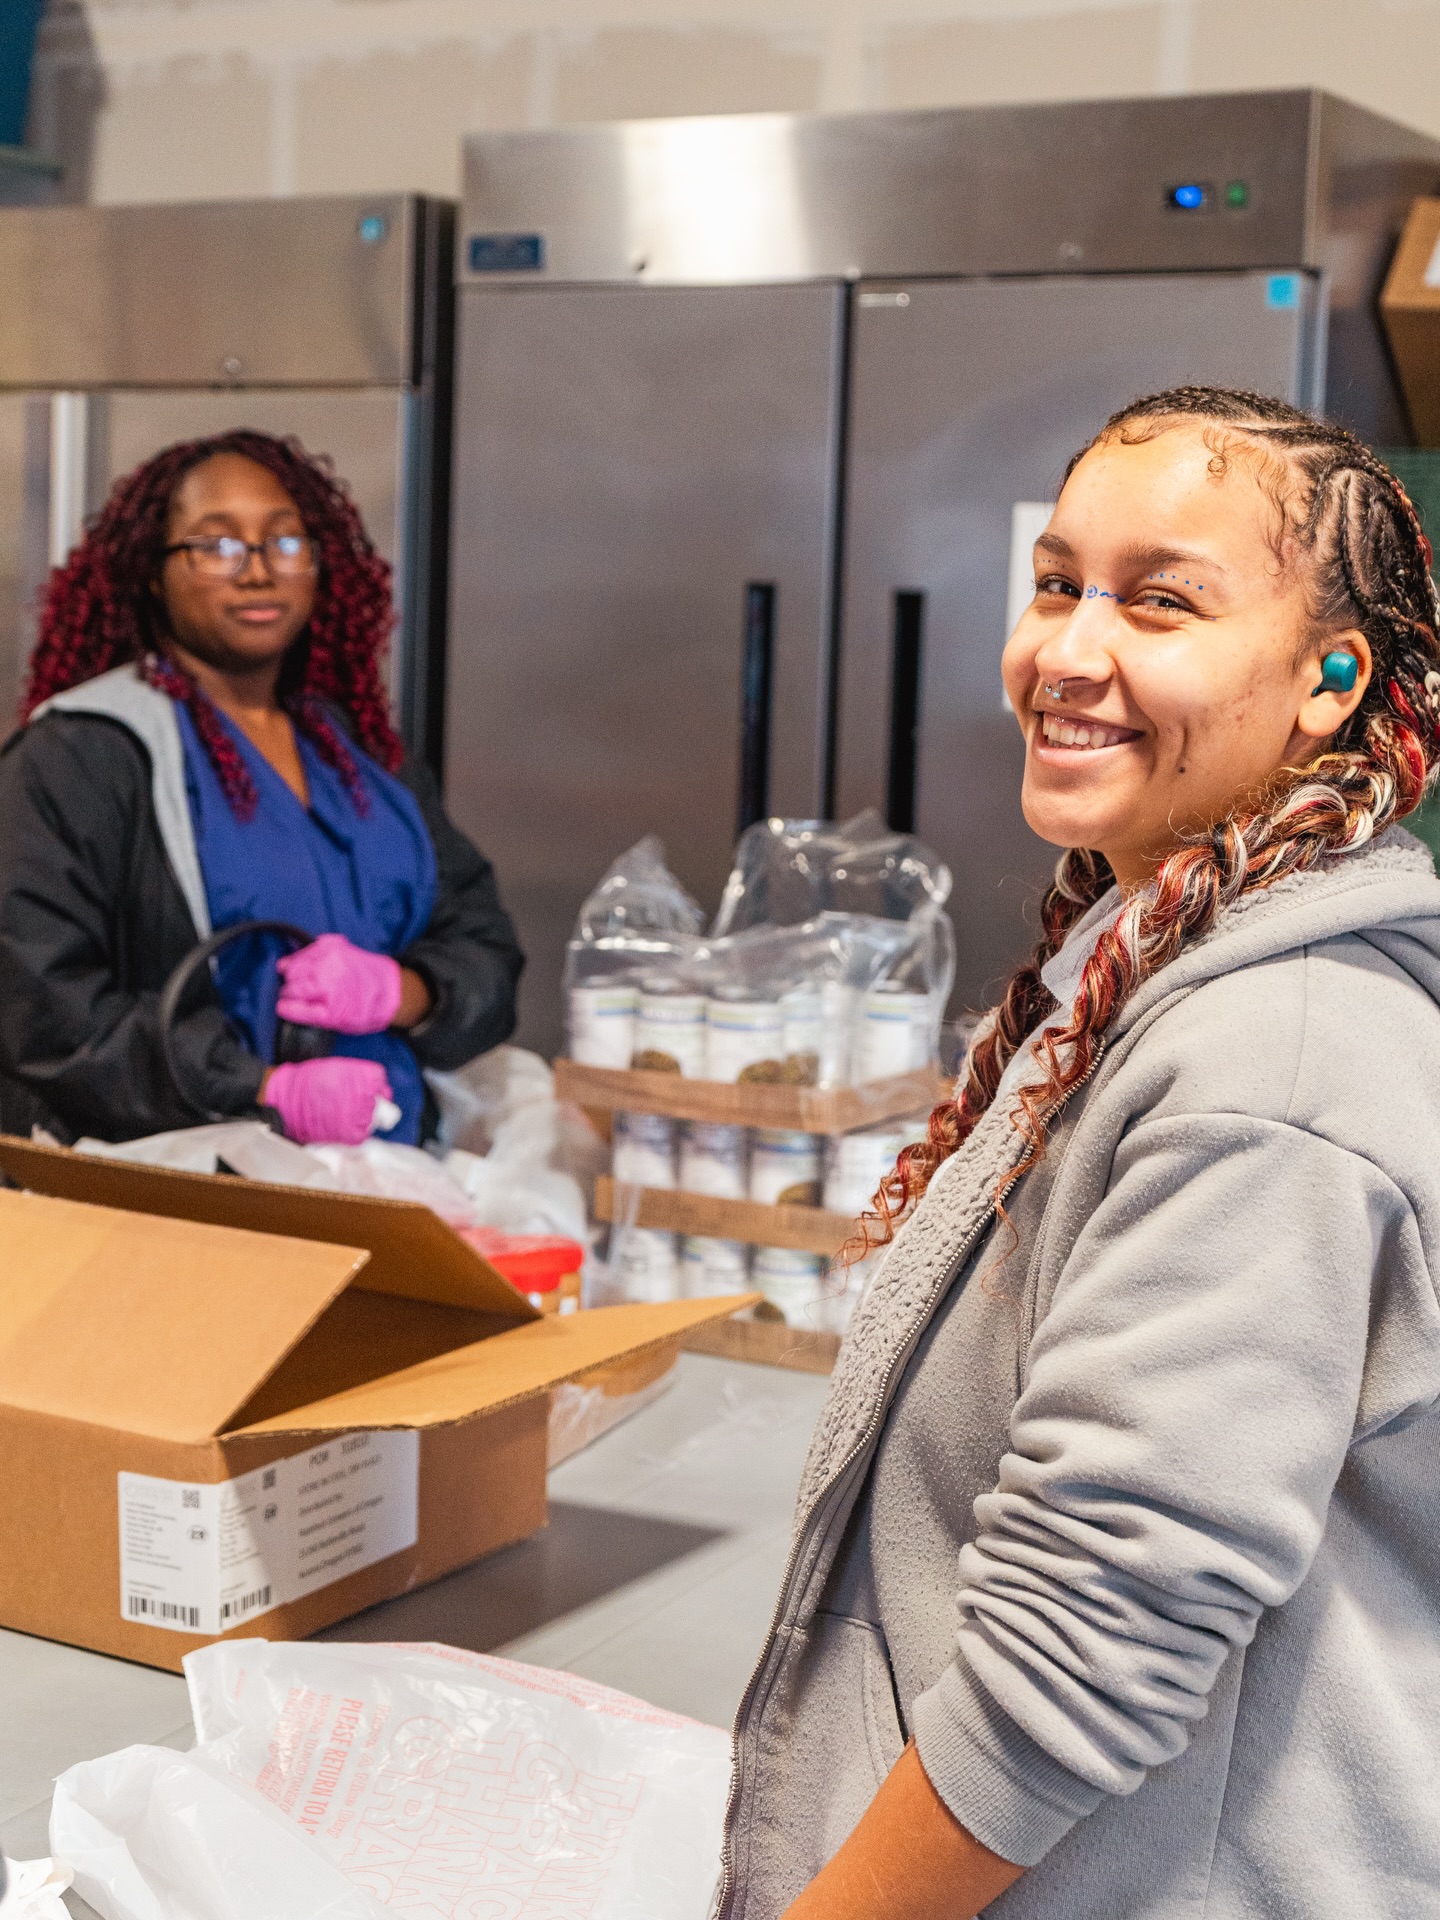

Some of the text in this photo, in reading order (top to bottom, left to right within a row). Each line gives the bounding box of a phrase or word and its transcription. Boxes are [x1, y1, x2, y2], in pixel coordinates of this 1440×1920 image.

[329, 1698, 364, 1747] PLEASE
[357, 1753, 374, 1767] A
[310, 1748, 349, 1798] RETURN
[303, 1800, 329, 1816] TO
[297, 1816, 320, 1825] A
[327, 1808, 354, 1840] Day
